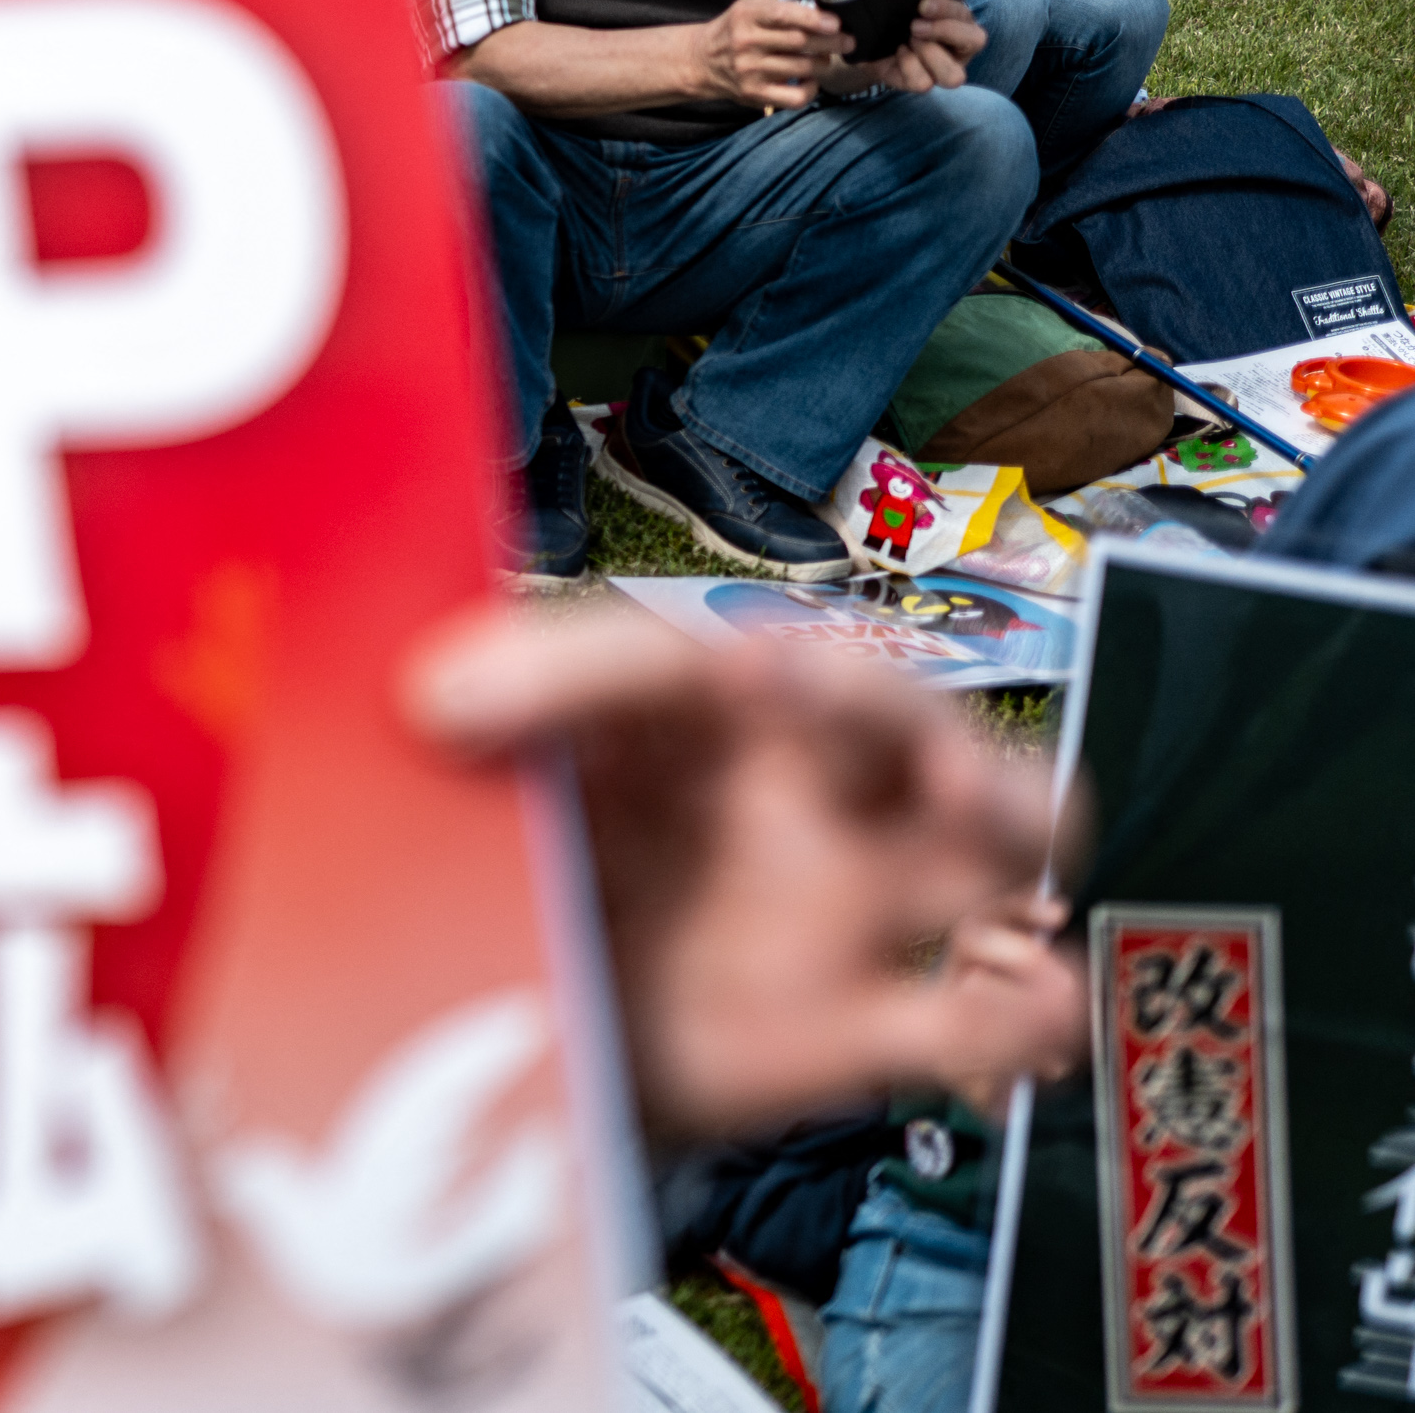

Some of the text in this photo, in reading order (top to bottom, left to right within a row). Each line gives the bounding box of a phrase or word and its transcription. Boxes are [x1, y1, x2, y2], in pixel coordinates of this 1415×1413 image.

[1302, 292, 1329, 305] CLASSIC
[1328, 286, 1356, 299] VINTAGE
[1355, 282, 1377, 295] STYLE
[1313, 309, 1356, 327] Traditional
[1126, 944, 1252, 1384] 改憲反対
